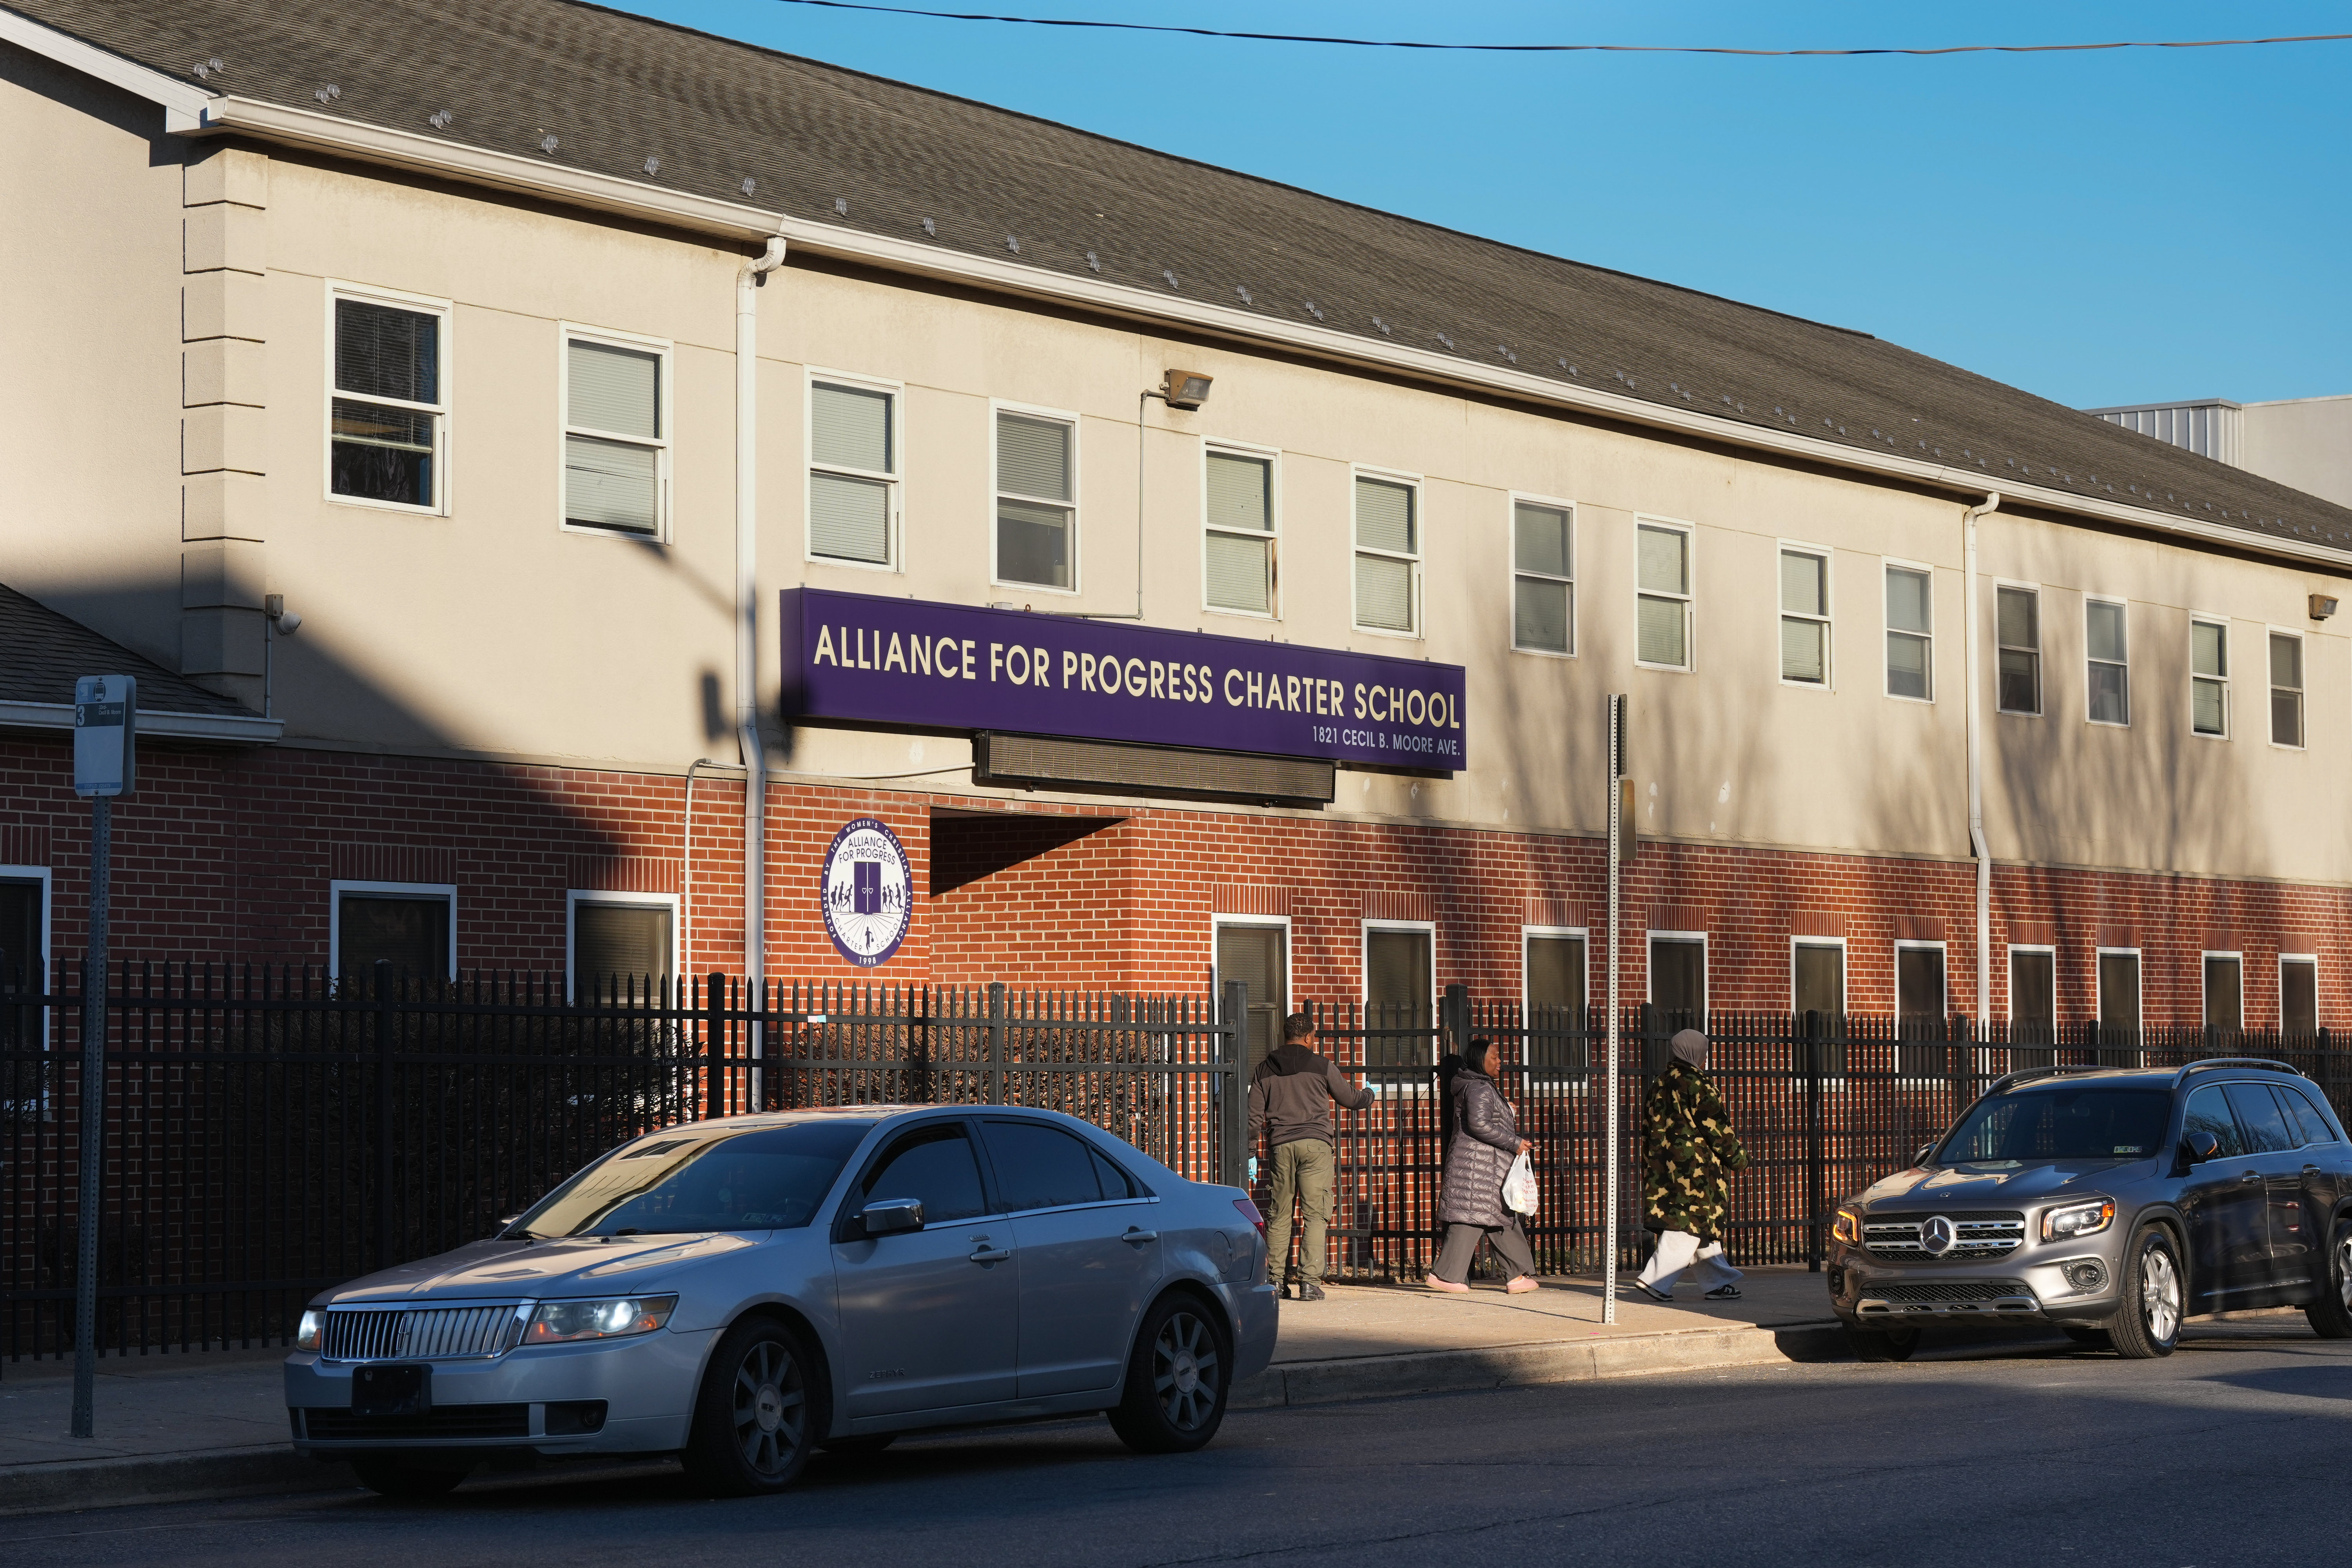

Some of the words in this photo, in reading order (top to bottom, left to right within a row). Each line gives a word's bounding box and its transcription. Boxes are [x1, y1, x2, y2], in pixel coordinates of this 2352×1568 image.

[813, 624, 976, 680] ALLIANCE
[991, 642, 1050, 687] FOR
[1063, 651, 1213, 704] PROGRESS
[1224, 669, 1344, 717] CHARTER
[1354, 683, 1459, 729] SCHOOL
[77, 705, 85, 726] 3
[1313, 726, 1338, 744] 1821
[1343, 729, 1375, 748] CECIL
[1379, 733, 1389, 748] B.
[1393, 734, 1433, 753] MOORE
[1437, 739, 1461, 755] AVE.
[846, 820, 878, 833] WOMEN'S
[831, 837, 841, 853] THE
[848, 836, 887, 850] ALLIANCE
[885, 829, 909, 878] CHRISTIAN
[838, 850, 854, 864] FOR
[857, 848, 896, 865] PROGRESS
[824, 863, 830, 875] BY
[823, 889, 837, 938] FOUNDED
[896, 891, 911, 942] ALLIANCE
[835, 918, 862, 952] CHARTER
[877, 918, 900, 950] SCHOOL
[869, 1368, 905, 1379] ZEPHYR
